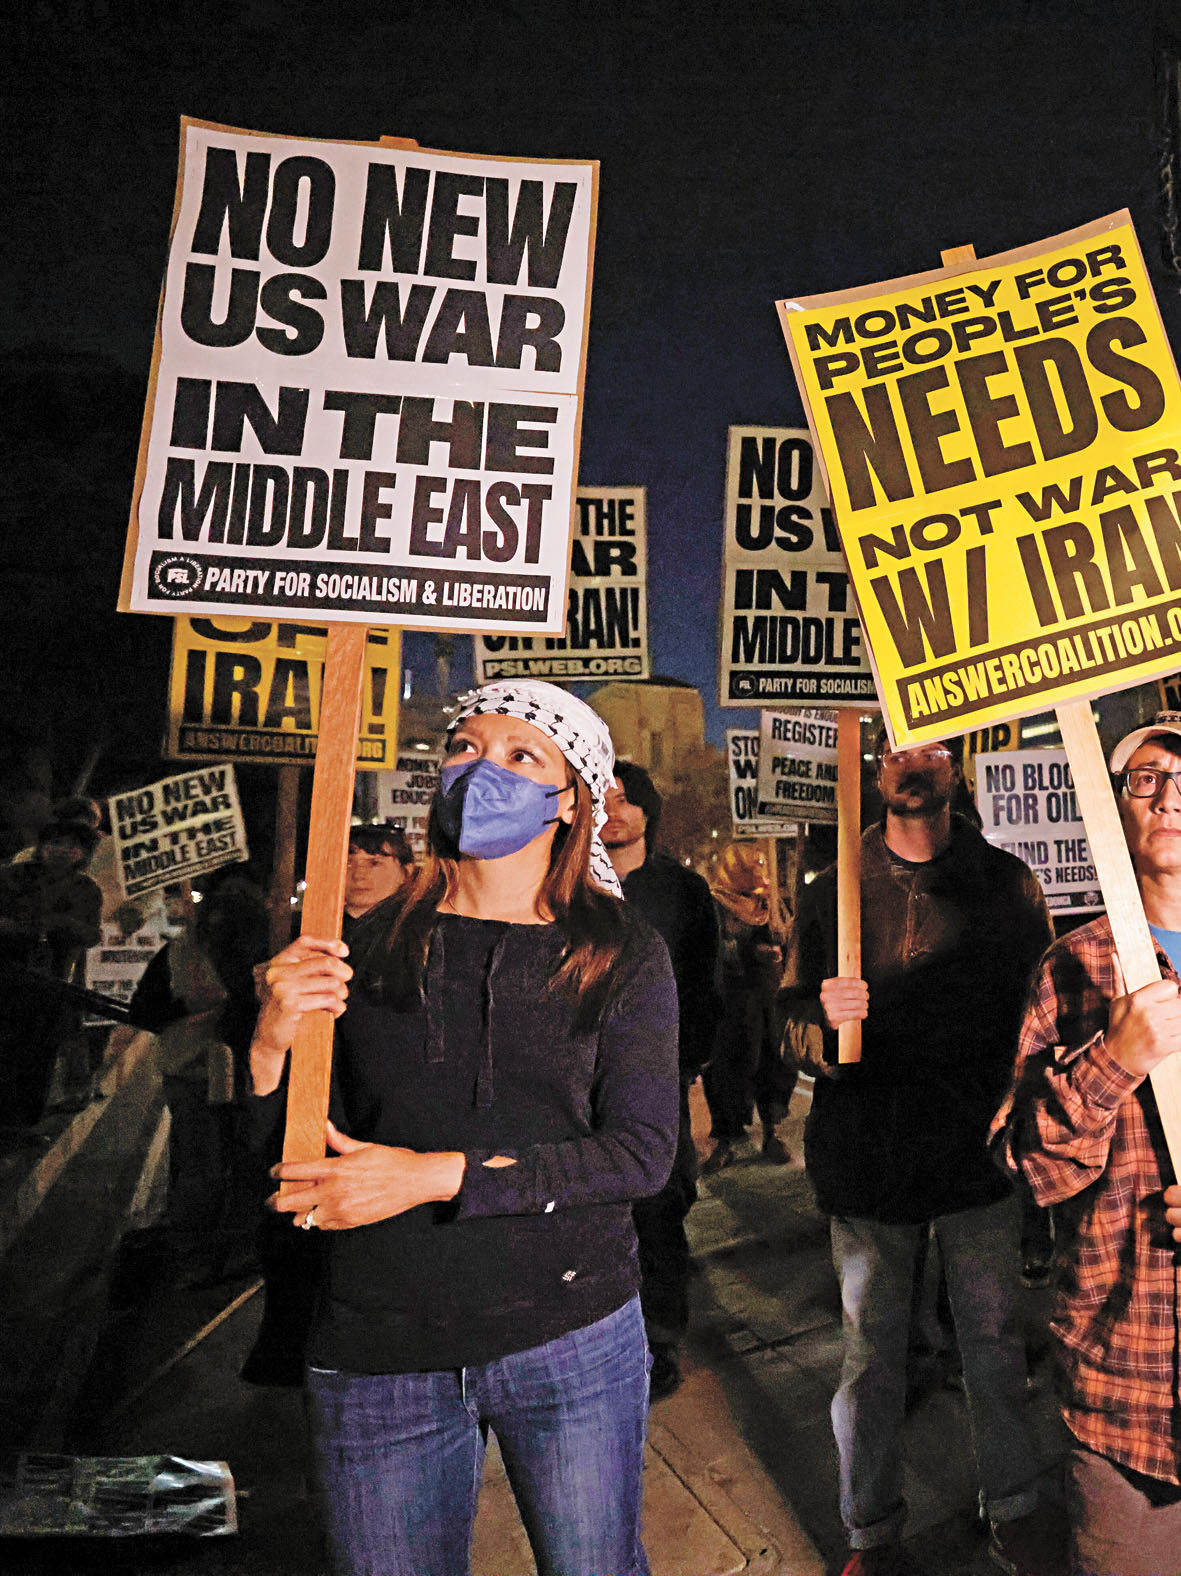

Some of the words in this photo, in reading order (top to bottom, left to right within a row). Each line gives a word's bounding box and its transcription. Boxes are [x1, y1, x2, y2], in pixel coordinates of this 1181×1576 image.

[191, 146, 336, 268] NO
[357, 162, 578, 289] NEW
[180, 262, 327, 356] US
[340, 279, 566, 372] WAR
[805, 280, 1002, 351] MONEY
[1015, 244, 1128, 301] FOR
[813, 276, 1136, 389] PEOPLE'S
[169, 377, 310, 456] IN
[323, 390, 559, 475] THE
[825, 317, 1166, 511] NEEDS
[738, 436, 814, 501] NO
[157, 456, 396, 553] MIDDLE
[409, 475, 552, 564] EAST
[576, 498, 635, 536] THE
[735, 503, 814, 552] US
[858, 499, 1002, 569] NOT
[204, 567, 270, 592] PARTY
[273, 571, 310, 598] FOR
[316, 575, 417, 602] SOCIALISM
[423, 580, 437, 604] &
[443, 582, 545, 611] LIBERATION
[734, 569, 807, 611] IN
[870, 548, 990, 669] W/
[545, 587, 641, 649] RAN!
[731, 616, 861, 667] MIDDLE
[182, 649, 388, 735] IRA!
[485, 657, 642, 677] PSLWEB.ORG
[759, 678, 794, 693] PARTY
[796, 679, 817, 693] FOR
[772, 757, 812, 778] PEACE
[775, 780, 835, 803] FREEDOM
[985, 764, 1015, 793] NO
[116, 790, 154, 822] NO
[162, 770, 226, 805] NEW
[119, 814, 158, 840] US
[161, 794, 232, 825] WAR
[992, 793, 1039, 826] FOR
[161, 814, 236, 845] THE
[1054, 839, 1088, 863] THE
[123, 844, 191, 880] MIDDLE
[195, 830, 236, 857] EAST
